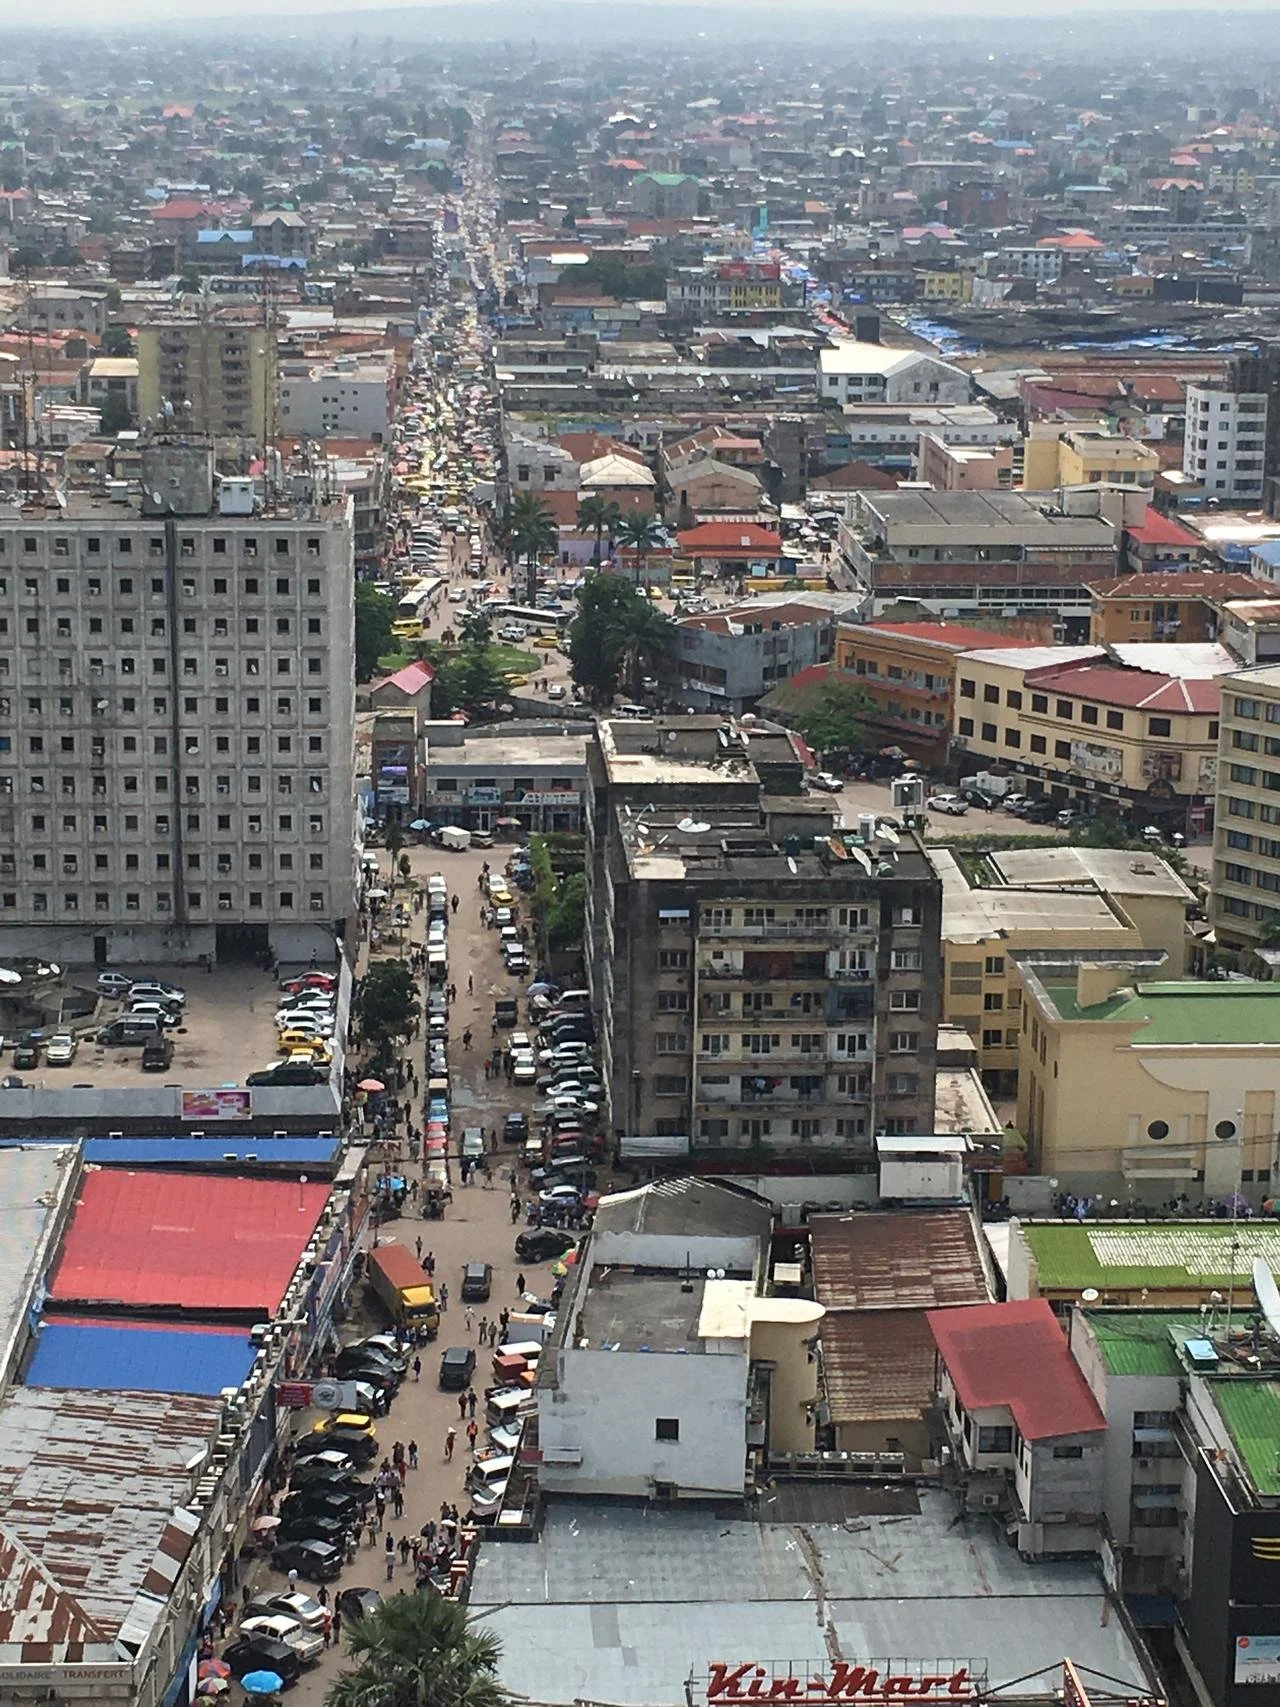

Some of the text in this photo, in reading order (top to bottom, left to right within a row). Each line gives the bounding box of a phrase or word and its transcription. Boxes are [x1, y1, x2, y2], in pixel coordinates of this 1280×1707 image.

[0, 1670, 123, 1679] OLIDAIRE TRANSFERT
[706, 1662, 971, 1697] Kin-Mart
